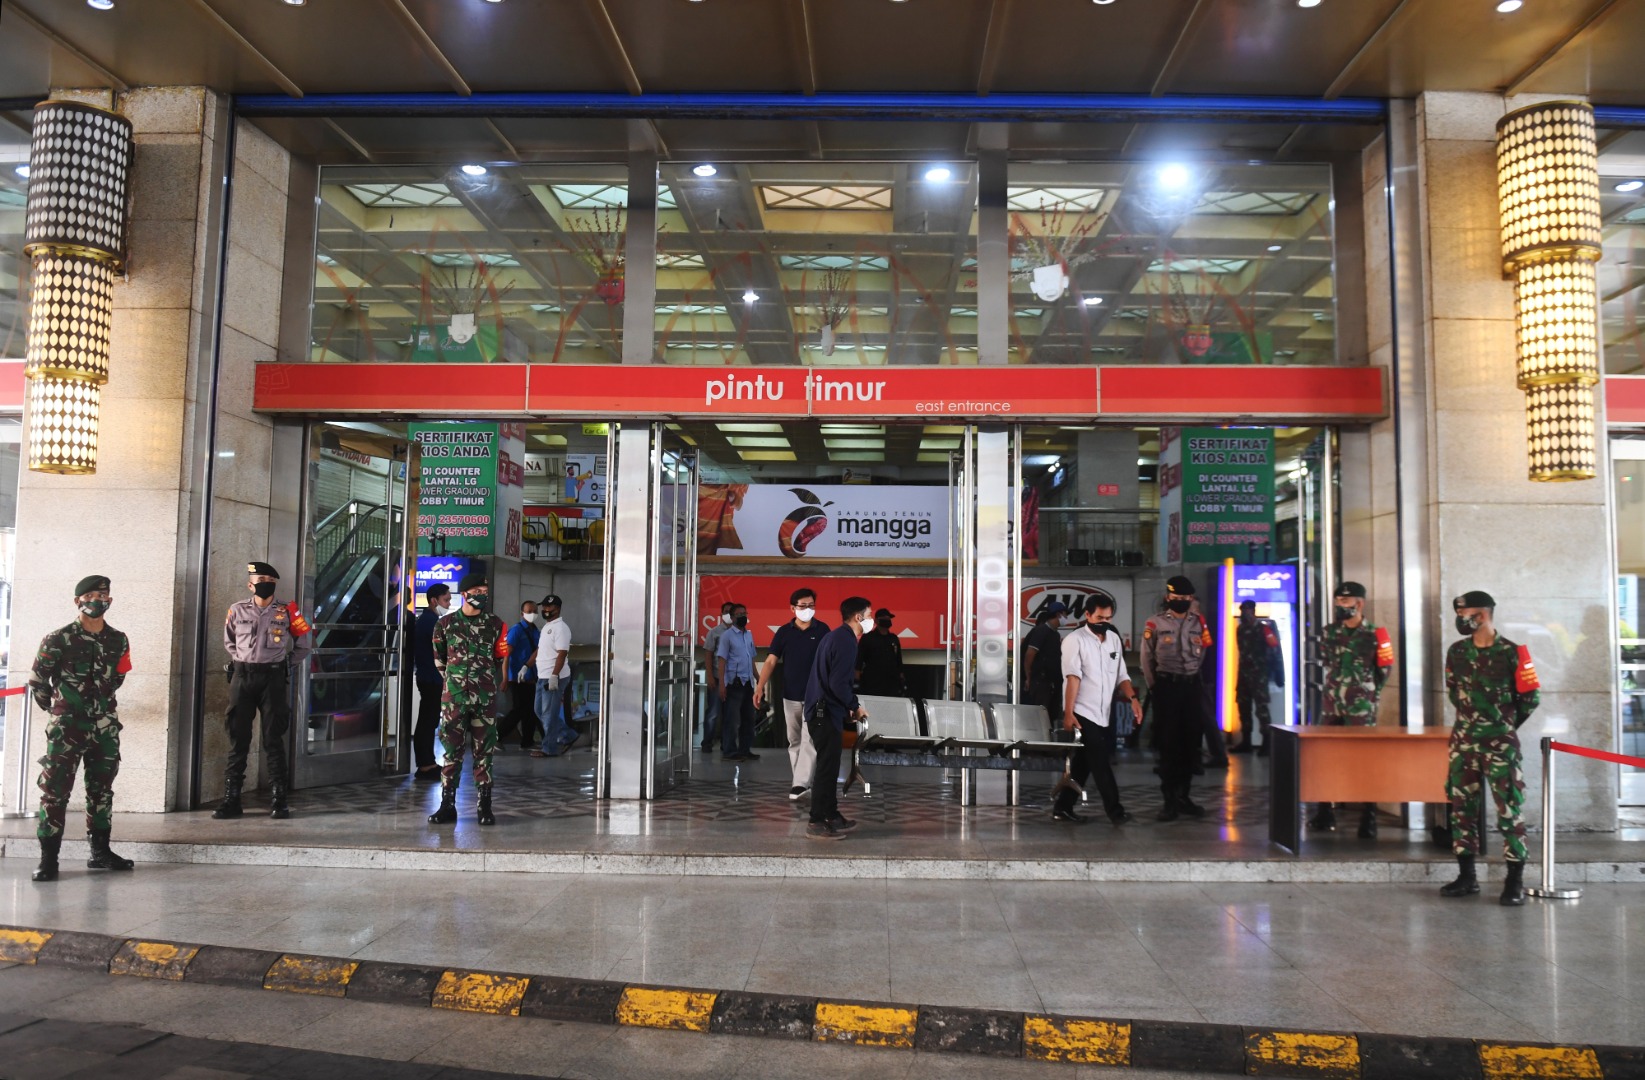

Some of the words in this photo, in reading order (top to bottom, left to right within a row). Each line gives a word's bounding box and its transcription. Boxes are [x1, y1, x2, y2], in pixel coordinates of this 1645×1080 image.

[705, 373, 784, 406] pintu
[803, 375, 886, 401] timur
[915, 400, 944, 412] east
[948, 400, 1011, 412] entrance
[414, 431, 494, 443] SERTIFIKAT
[1188, 438, 1268, 450] SERTIFIKAT
[452, 445, 491, 457] ANDA
[1191, 452, 1225, 464] KIOS
[1228, 452, 1267, 464] ANDA
[524, 460, 542, 471] NA
[422, 467, 432, 476] DI
[434, 467, 480, 476] COUNTER
[425, 478, 462, 486] LANTAI.
[464, 478, 477, 486] LG
[1198, 474, 1209, 482] DI
[1211, 474, 1258, 482] COUNTER
[419, 487, 444, 495] OWER
[444, 487, 491, 496] GRAOUND)
[1242, 484, 1255, 492] LG
[454, 497, 484, 506] TIMUR
[1194, 504, 1226, 512] LOBBY
[1232, 504, 1264, 512] TIMUR
[438, 515, 490, 524] 23570600
[838, 518, 930, 539] mangga
